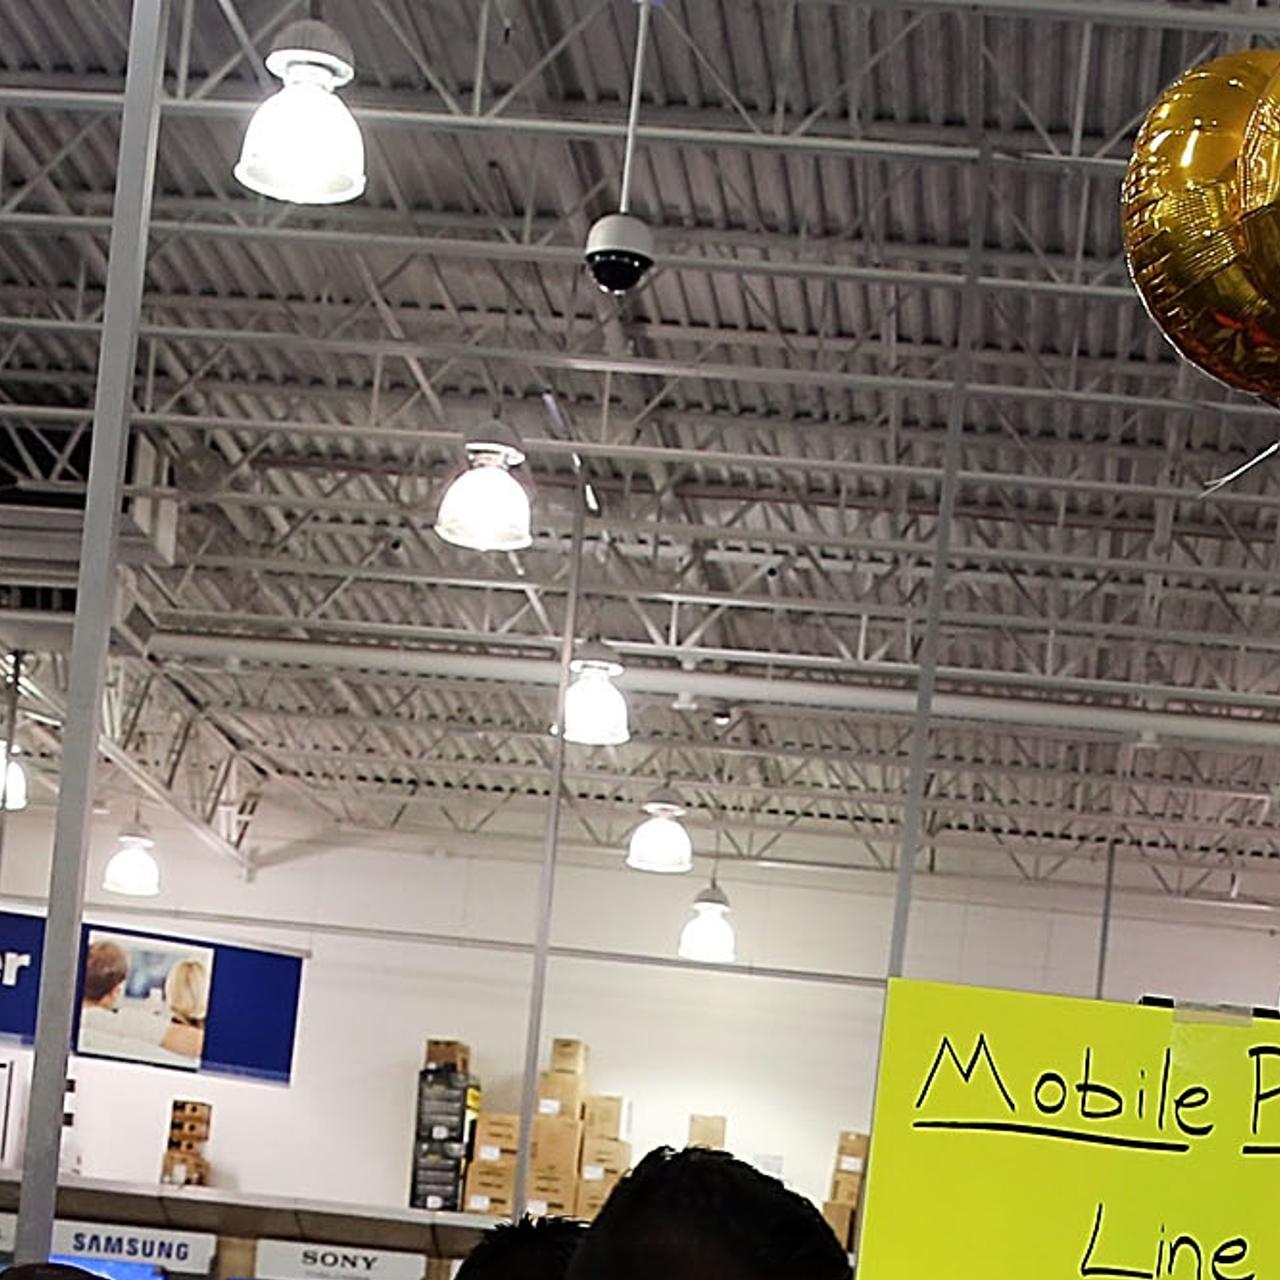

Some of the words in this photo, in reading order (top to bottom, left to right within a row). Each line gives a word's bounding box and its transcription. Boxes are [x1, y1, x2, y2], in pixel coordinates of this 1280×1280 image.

[915, 1033, 1214, 1139] Mobile
[72, 1230, 190, 1263] SAMSUNG
[301, 1249, 379, 1271] SONY
